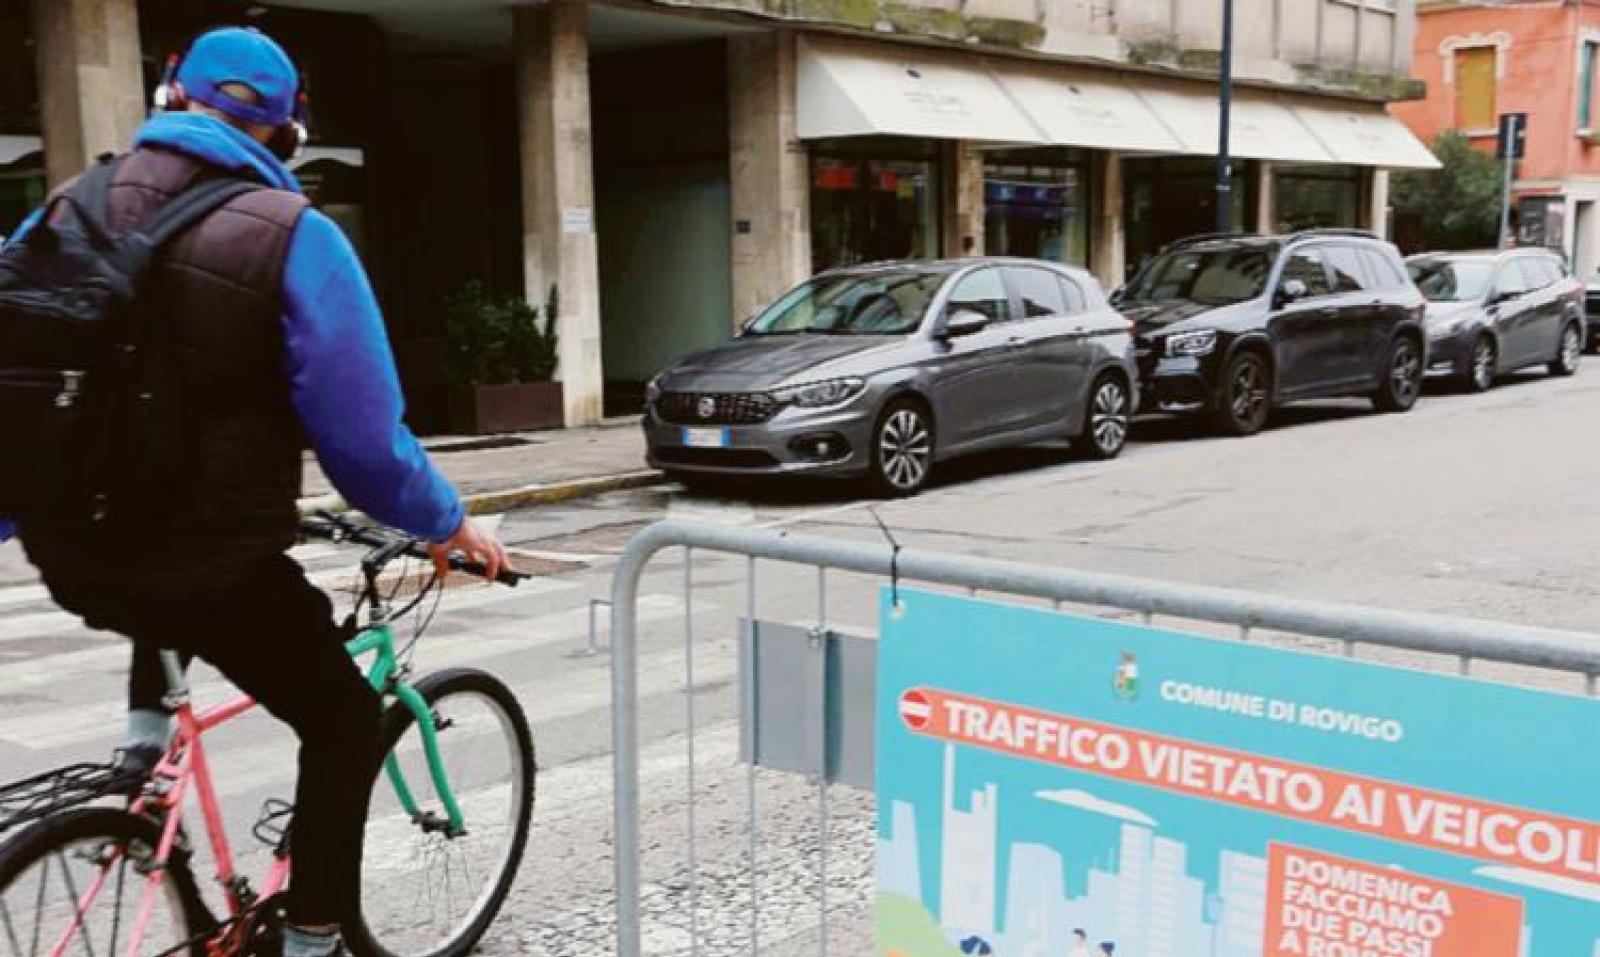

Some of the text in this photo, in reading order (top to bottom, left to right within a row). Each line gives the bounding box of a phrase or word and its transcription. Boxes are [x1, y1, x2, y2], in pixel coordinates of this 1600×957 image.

[1160, 680, 1403, 742] COMUNE DI ROVIGO
[943, 700, 1600, 873] TRAFFICO VIETATO AI VEICOL
[1284, 880, 1444, 938] FACCIAMO
[1285, 855, 1454, 916] DOMENICA
[1280, 928, 1300, 954] A
[1281, 904, 1432, 957] DUE PASSI
